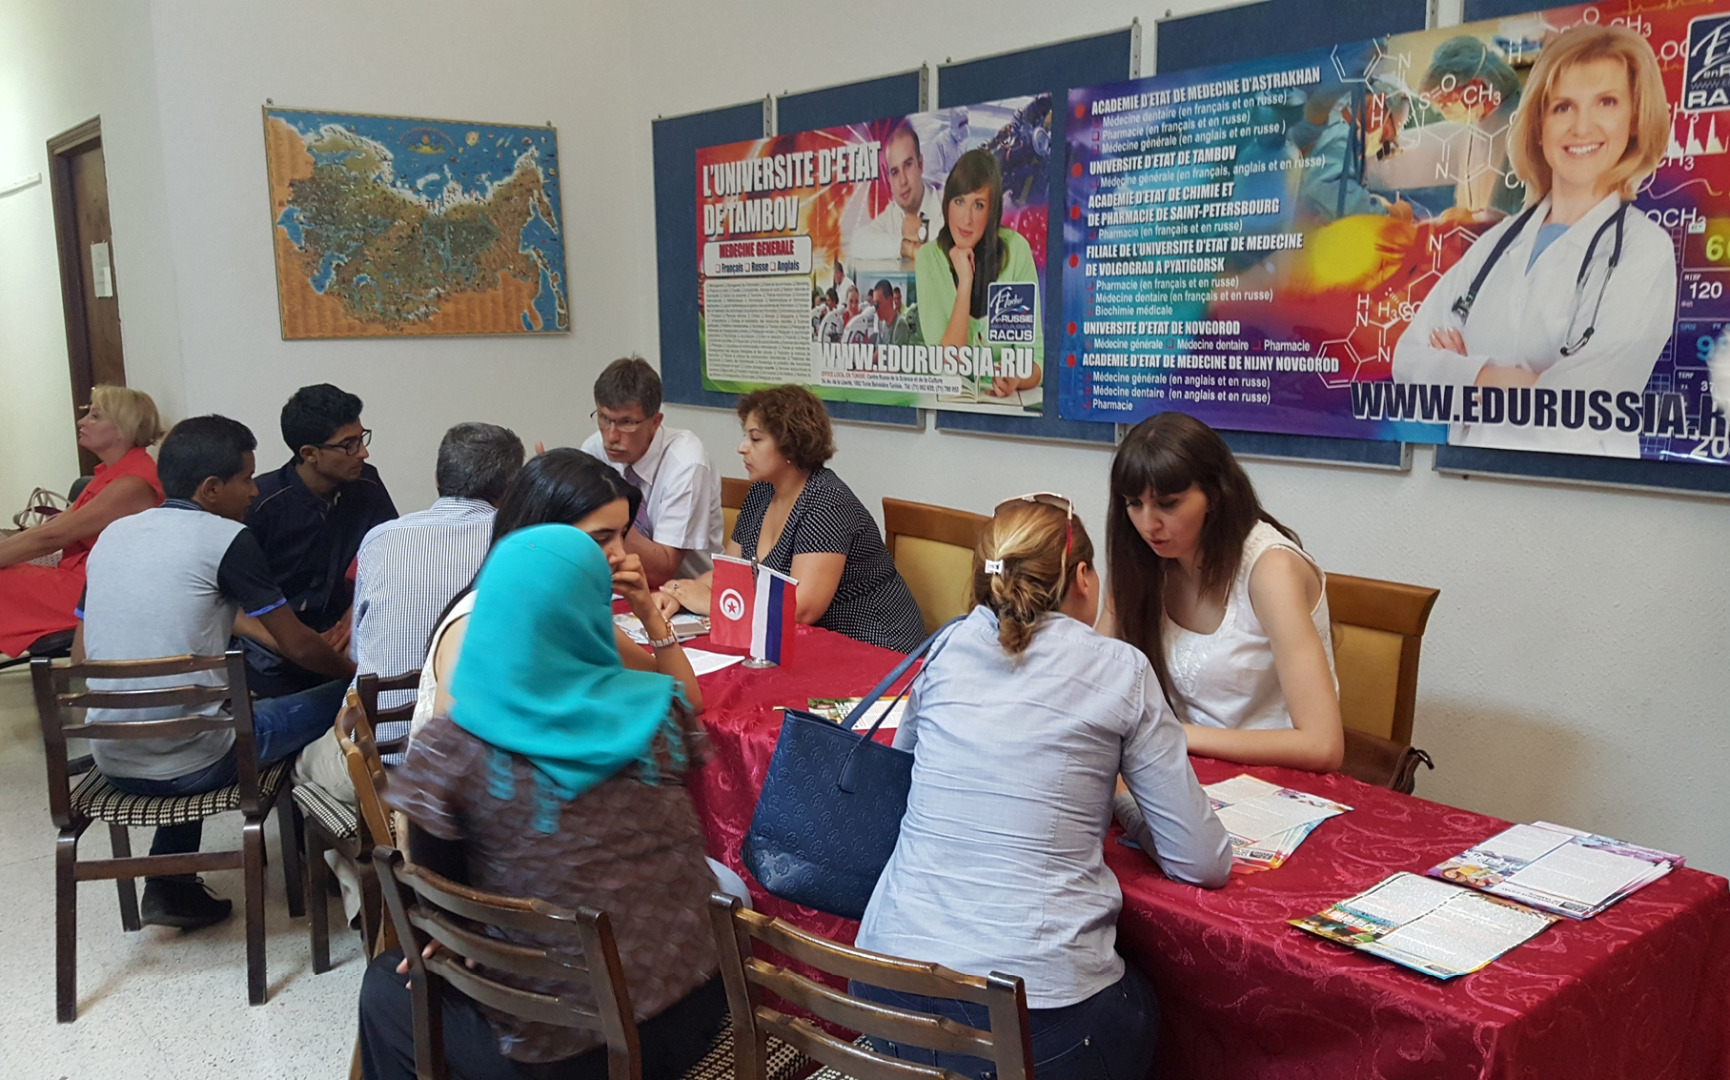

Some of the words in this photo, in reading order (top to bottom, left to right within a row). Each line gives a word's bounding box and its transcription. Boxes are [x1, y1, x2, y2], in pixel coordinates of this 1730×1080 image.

[1399, 52, 1411, 70] N
[1092, 94, 1140, 116] ACADEMIE
[1141, 91, 1171, 109] D'ETAT
[1173, 88, 1186, 104] DE
[1187, 79, 1240, 101] MEDECINE
[1242, 66, 1320, 93] D'ASTRAKHAN
[1103, 114, 1140, 128] Médecine
[1143, 108, 1176, 121] dentaire
[1179, 106, 1192, 119] (en
[1194, 98, 1230, 115] français
[1232, 97, 1241, 109] et
[1243, 98, 1255, 108] en
[1257, 90, 1287, 106] russe)
[1372, 92, 1385, 111] N
[1103, 128, 1143, 140] Pharmacie
[1146, 125, 1159, 137] (en
[1161, 118, 1195, 133] français
[1197, 116, 1206, 128] et
[1208, 116, 1219, 127] en
[1222, 110, 1250, 125] russe)
[1101, 141, 1138, 154] Médecine
[1141, 137, 1177, 152] générale
[1179, 133, 1192, 147] (en
[1194, 127, 1227, 144] anglais
[1229, 127, 1238, 139] et
[1240, 127, 1251, 137] en
[703, 150, 815, 198] L'UNIVERSITE
[818, 141, 881, 186] D'ETAT
[1089, 156, 1143, 176] UNIVERSITE
[1144, 152, 1176, 170] D'ETAT
[1178, 150, 1191, 165] DE
[1192, 145, 1237, 164] TAMBOV
[1101, 175, 1137, 188] Médecine
[1138, 171, 1174, 186] générale
[1177, 168, 1190, 182] (en
[1192, 163, 1230, 179] français,
[1233, 160, 1266, 176] anglais
[1268, 159, 1278, 171] et
[1280, 160, 1291, 170] en
[1294, 154, 1325, 169] russe)
[1435, 162, 1449, 180] N
[1088, 191, 1134, 209] ACADEMIE
[1136, 189, 1166, 205] D'ETAT
[1168, 187, 1181, 202] DE
[1183, 183, 1220, 200] CHIMIE
[1222, 182, 1235, 197] ET
[703, 203, 724, 237] DE
[727, 195, 800, 235] TAMBOV
[1088, 213, 1100, 227] DE
[1101, 208, 1154, 226] PHARMACIE
[1156, 207, 1168, 221] DE
[1170, 198, 1280, 220] SAINT-PETERSBOURG
[1098, 227, 1138, 240] Pharmacie
[1140, 226, 1153, 238] (en
[1155, 223, 1188, 237] français
[1190, 223, 1198, 233] et
[1201, 223, 1211, 233] en
[1214, 218, 1243, 234] russe)
[719, 241, 755, 259] MEDECINE
[757, 239, 795, 257] GENERALE
[1086, 244, 1118, 259] FILIALE
[1120, 243, 1131, 257] DE
[1133, 239, 1194, 257] L'UNIVERSITE
[1196, 237, 1229, 254] D'ETAT
[1231, 236, 1244, 251] DE
[1246, 233, 1303, 251] MEDECINE
[1429, 234, 1442, 253] N
[1706, 234, 1730, 261] 6
[721, 262, 744, 275] Français
[751, 261, 769, 272] Russe
[777, 260, 800, 273] Anglais
[1085, 263, 1097, 277] DE
[1099, 261, 1154, 276] VOLGOGRAD
[1155, 260, 1162, 274] A
[1164, 257, 1225, 274] PYATIGORSK
[1096, 280, 1137, 291] Pharmacie
[1140, 279, 1152, 291] (en
[1154, 277, 1187, 291] français
[1189, 277, 1197, 288] et
[1198, 278, 1209, 288] en
[1211, 275, 1239, 289] russe)
[1689, 281, 1723, 300] 120
[1095, 292, 1133, 304] Médecine
[1135, 291, 1168, 303] dentaire
[1170, 289, 1183, 304] (en
[1185, 290, 1218, 304] français
[1220, 290, 1229, 301] et
[1231, 291, 1242, 301] en
[1244, 288, 1273, 304] russe)
[1095, 305, 1134, 316] Biochimie
[1136, 304, 1173, 316] médicale
[990, 329, 1033, 341] RACUS
[1083, 321, 1137, 335] UNIVERSITE
[1138, 321, 1169, 335] D'ETAT
[1171, 321, 1184, 335] DE
[1185, 320, 1240, 335] NOVGOROD
[1094, 338, 1128, 349] Médecine
[1130, 338, 1163, 351] générale
[1177, 338, 1213, 350] Médecine
[1216, 339, 1249, 351] dentaire
[1264, 339, 1310, 352] Pharmacie
[1378, 346, 1391, 363] N
[820, 341, 1034, 379] WWW.EDURUSSIA.RU
[1082, 353, 1128, 367] ACADEMIE
[1130, 354, 1161, 368] D'ETAT
[1163, 354, 1175, 368] DE
[1177, 354, 1227, 370] MEDECINE
[1229, 355, 1242, 370] DE
[1244, 356, 1273, 371] NIJNY
[1276, 356, 1339, 372] NOVGOROD
[1093, 371, 1129, 383] Médecine
[1132, 371, 1167, 386] générale
[1169, 373, 1182, 387] (en
[1184, 374, 1215, 388] anglais
[1217, 375, 1226, 386] et
[1228, 377, 1239, 387] en
[1242, 376, 1270, 390] russe)
[1092, 398, 1133, 411] Pharmacie
[1093, 385, 1129, 397] Médecine
[1131, 386, 1165, 399] dentaire
[1169, 388, 1182, 401] (en
[1184, 388, 1215, 402] anglais
[1217, 390, 1226, 401] et
[1228, 391, 1239, 402] en
[1242, 391, 1270, 406] russe)
